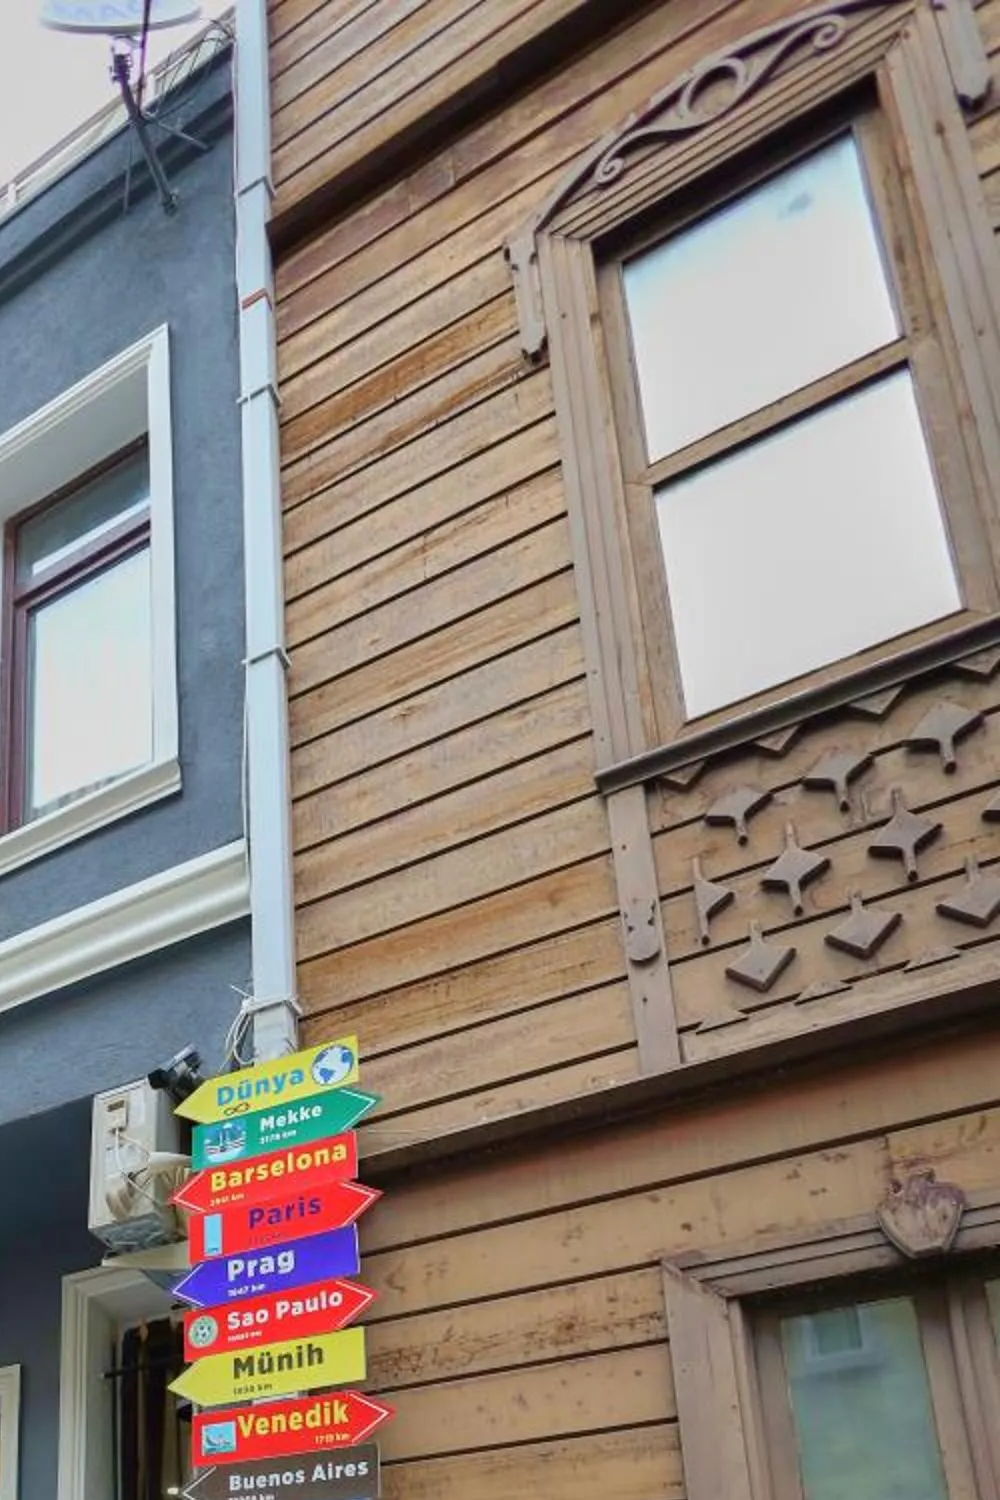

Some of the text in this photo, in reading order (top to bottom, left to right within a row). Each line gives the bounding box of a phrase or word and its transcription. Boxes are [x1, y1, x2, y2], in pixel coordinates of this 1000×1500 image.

[217, 1067, 305, 1107] Dünya
[259, 1104, 322, 1132] Mekke
[210, 1144, 347, 1192] Barselona
[249, 1196, 322, 1229] Paris
[227, 1250, 295, 1282] Prag
[227, 1291, 343, 1330] Sao Paulo
[233, 1343, 324, 1380] Münih
[237, 1399, 349, 1439] Venedik
[229, 1460, 369, 1491] Buenos Aires
